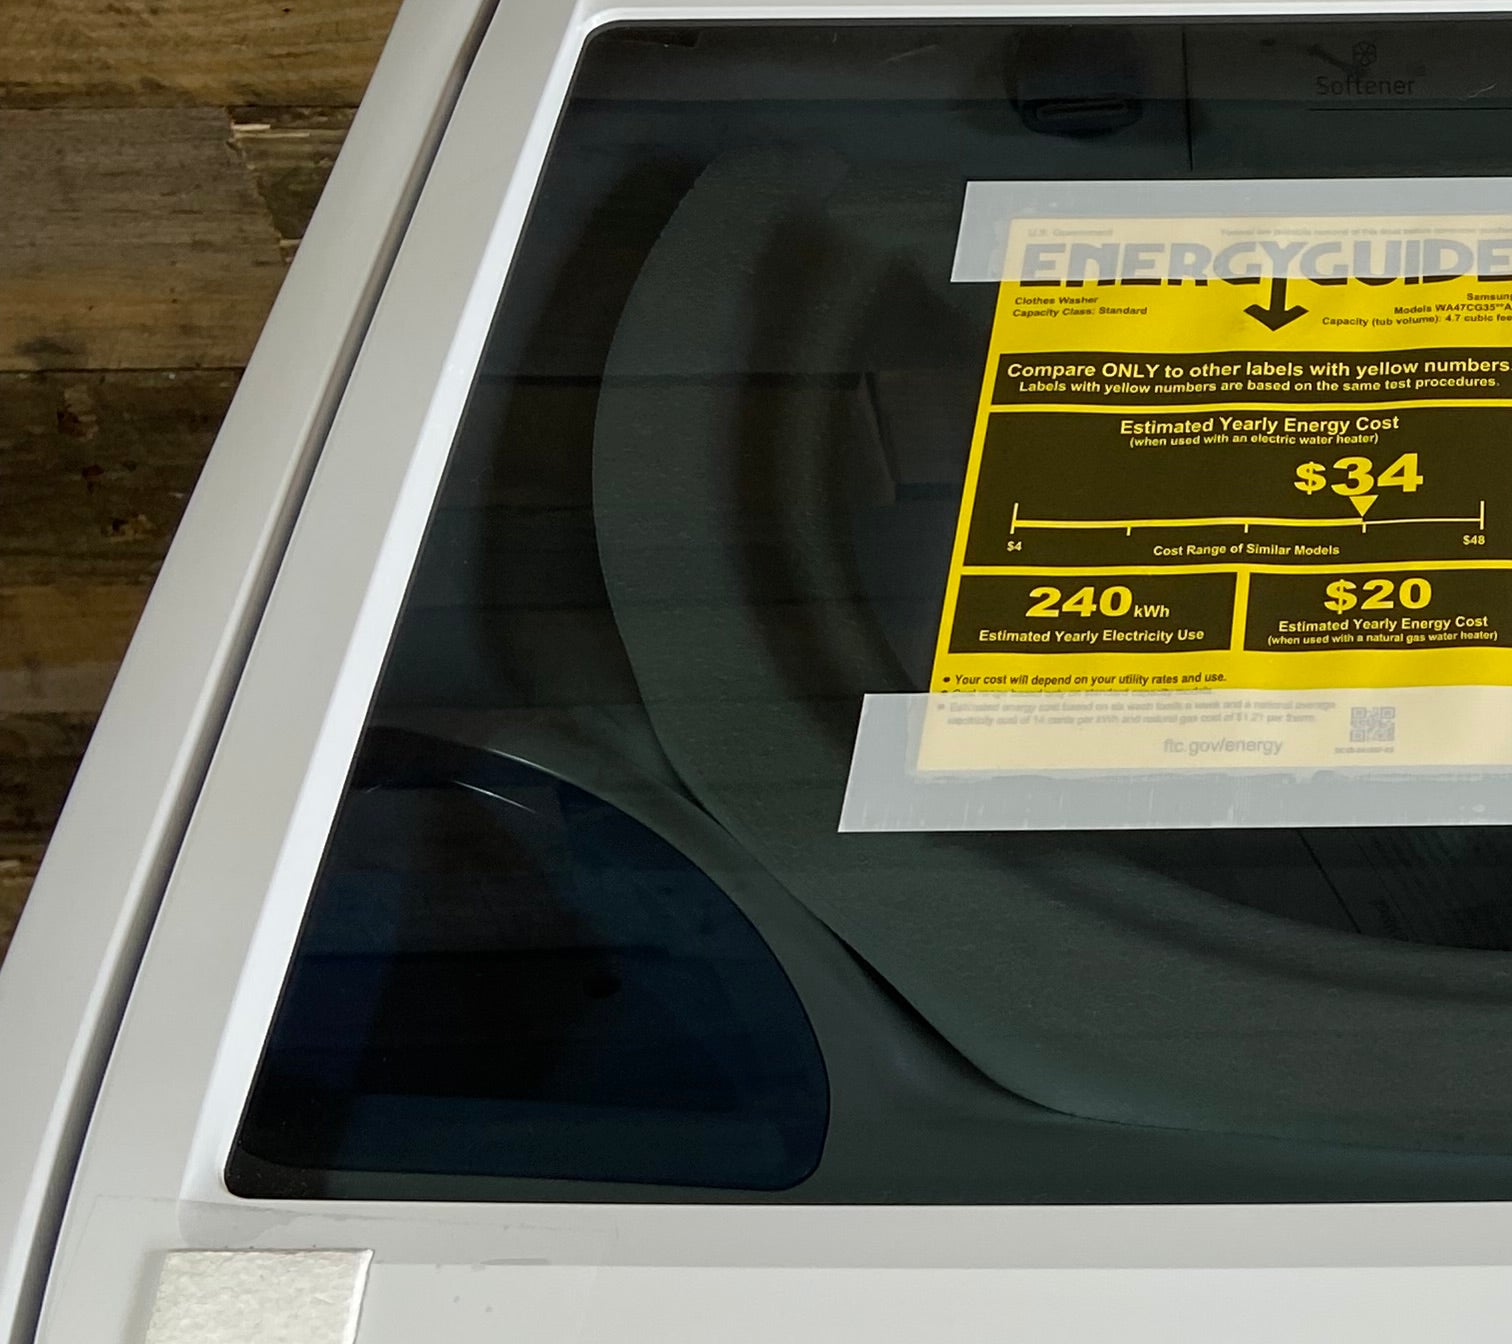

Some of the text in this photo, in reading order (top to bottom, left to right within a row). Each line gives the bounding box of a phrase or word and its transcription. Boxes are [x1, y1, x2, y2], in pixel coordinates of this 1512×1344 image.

[1315, 74, 1415, 95] Softener
[1013, 308, 1060, 318] Capacity
[1099, 307, 1147, 315] Standard
[1007, 363, 1096, 379] Compare
[1102, 364, 1159, 378] ONLY
[1165, 365, 1183, 378] to
[1189, 363, 1240, 377] other
[1247, 362, 1303, 376] labels
[1310, 363, 1350, 376] with
[1356, 362, 1418, 380] yellow
[1121, 416, 1399, 435] Estimated Yearly Energy Cost
[1294, 452, 1423, 496] $34
[1007, 541, 1022, 552] $4
[1463, 535, 1485, 546] $48
[1153, 544, 1340, 556] Cost Range of Similar Models
[1025, 586, 1170, 618] 240 kWh
[1324, 578, 1432, 614] $20
[1278, 616, 1488, 632] Estimated Yearly Energy Cost
[979, 629, 1204, 644] Estimated Yearly Electricity Use
